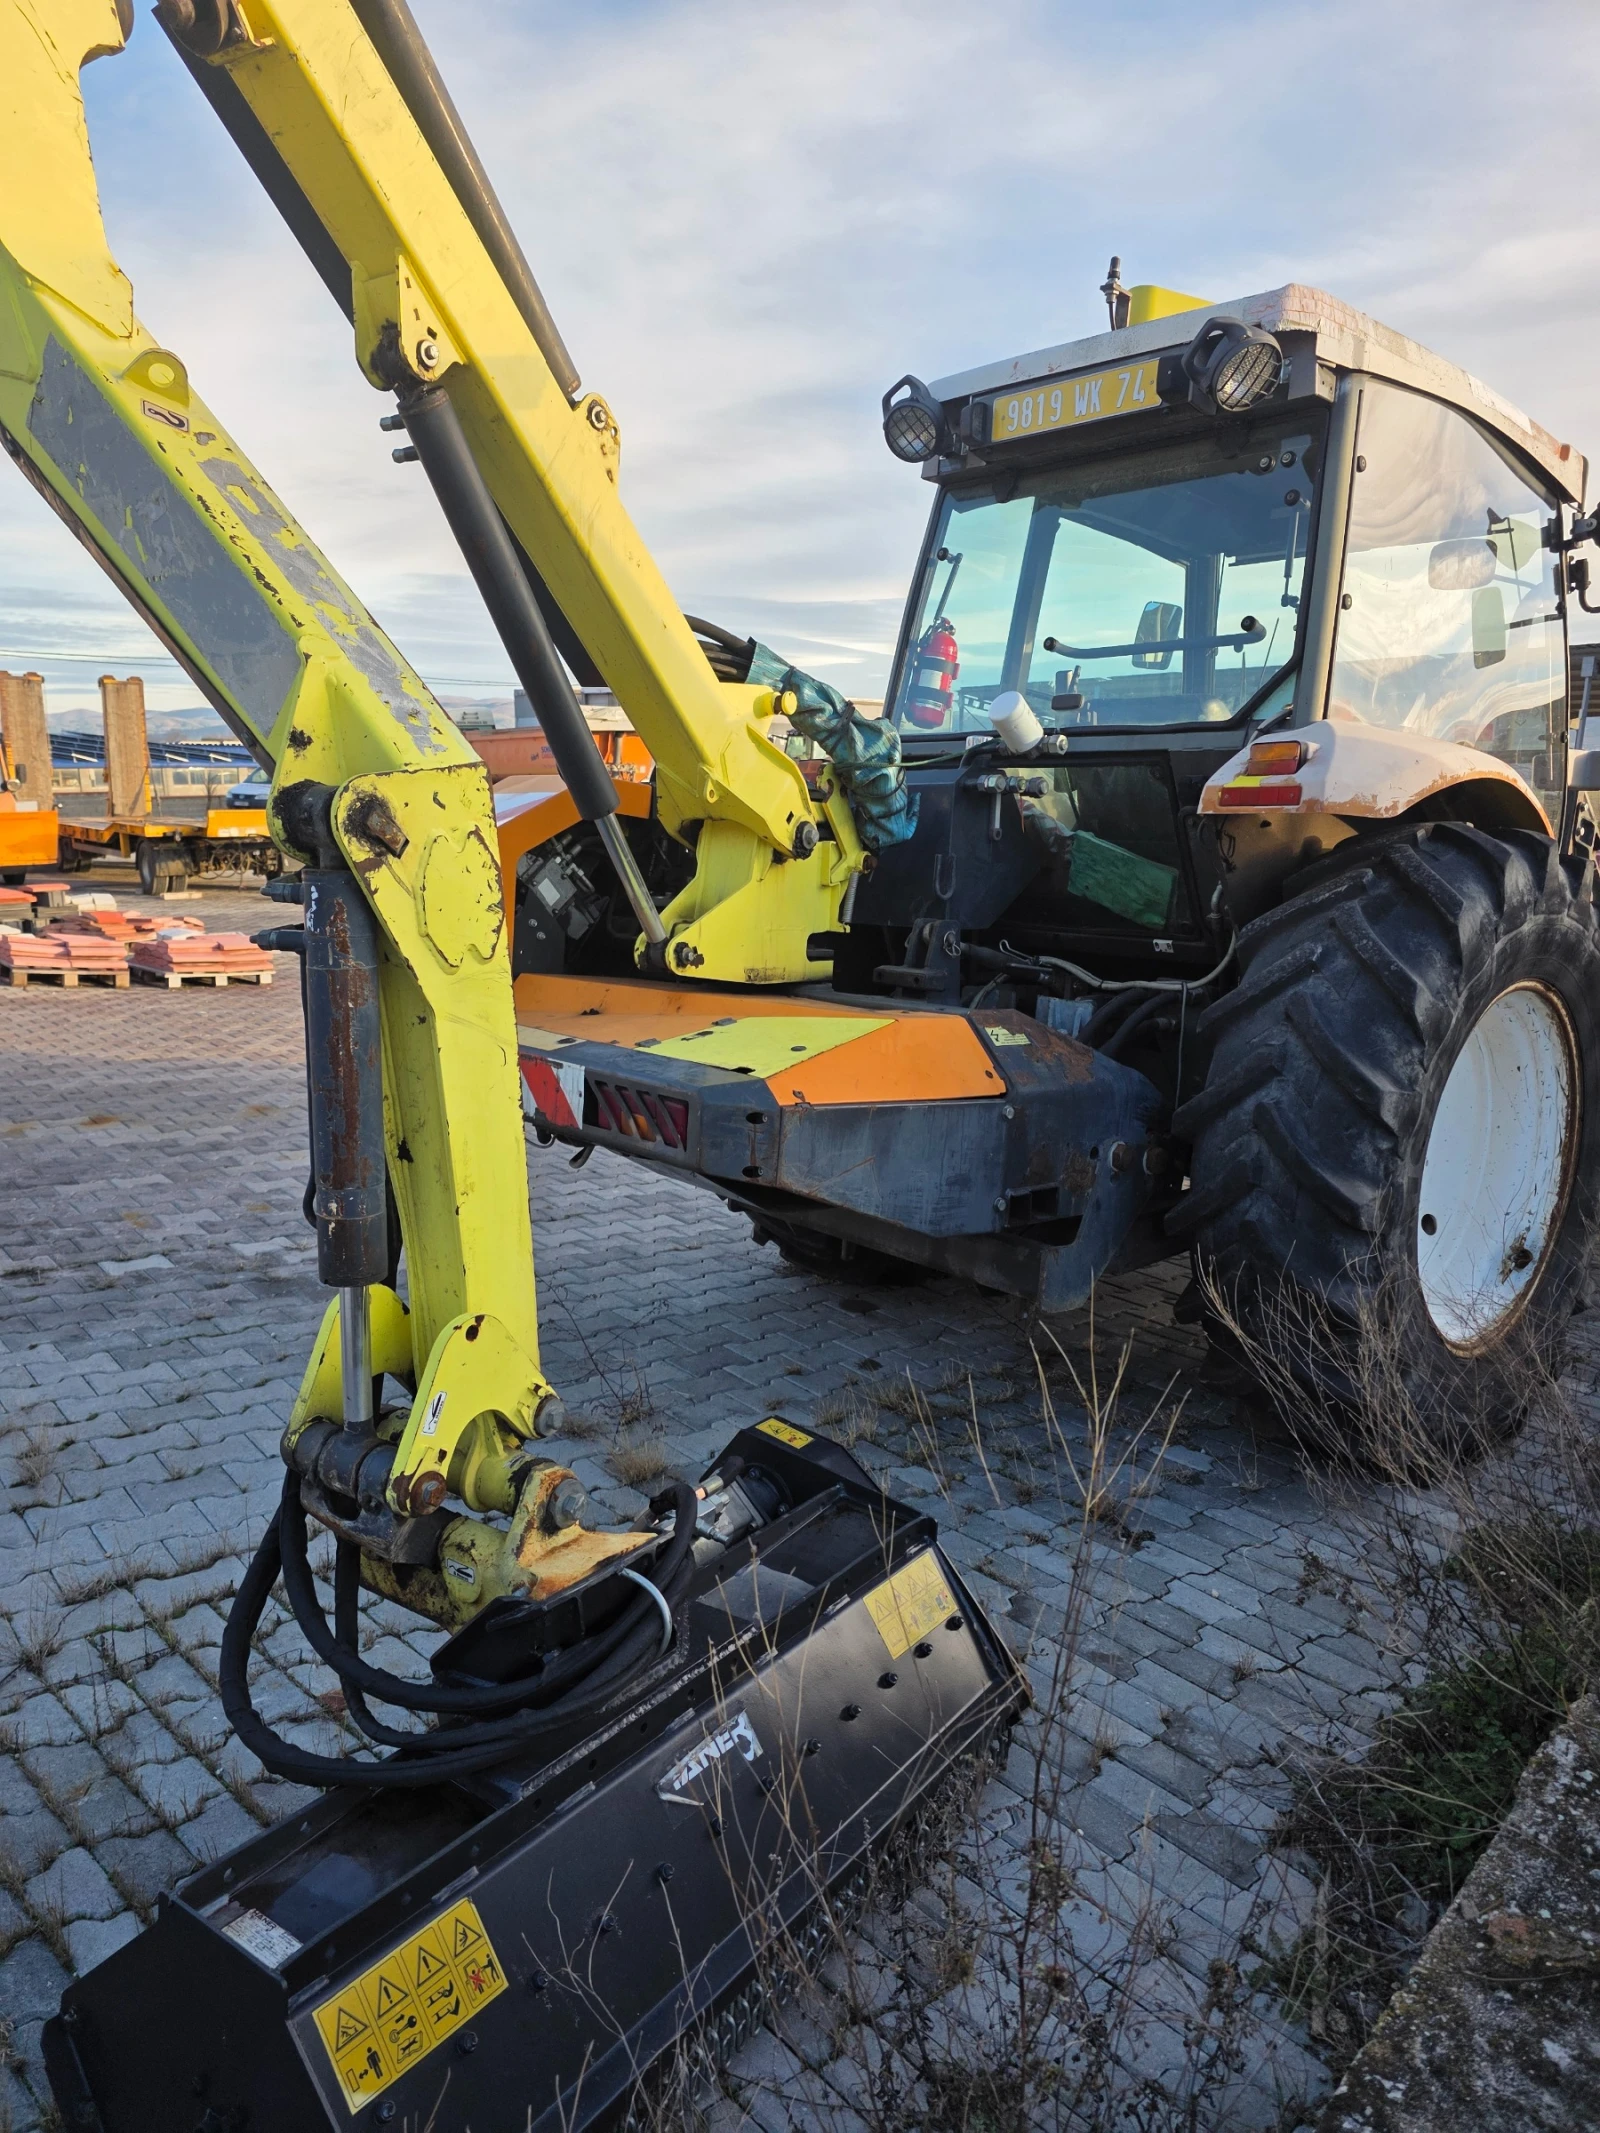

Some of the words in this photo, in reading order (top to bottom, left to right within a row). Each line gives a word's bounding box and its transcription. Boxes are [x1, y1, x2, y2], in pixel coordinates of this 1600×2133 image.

[1007, 389, 1062, 432] 9819
[1074, 378, 1102, 418] WK
[1116, 369, 1145, 409] 74
